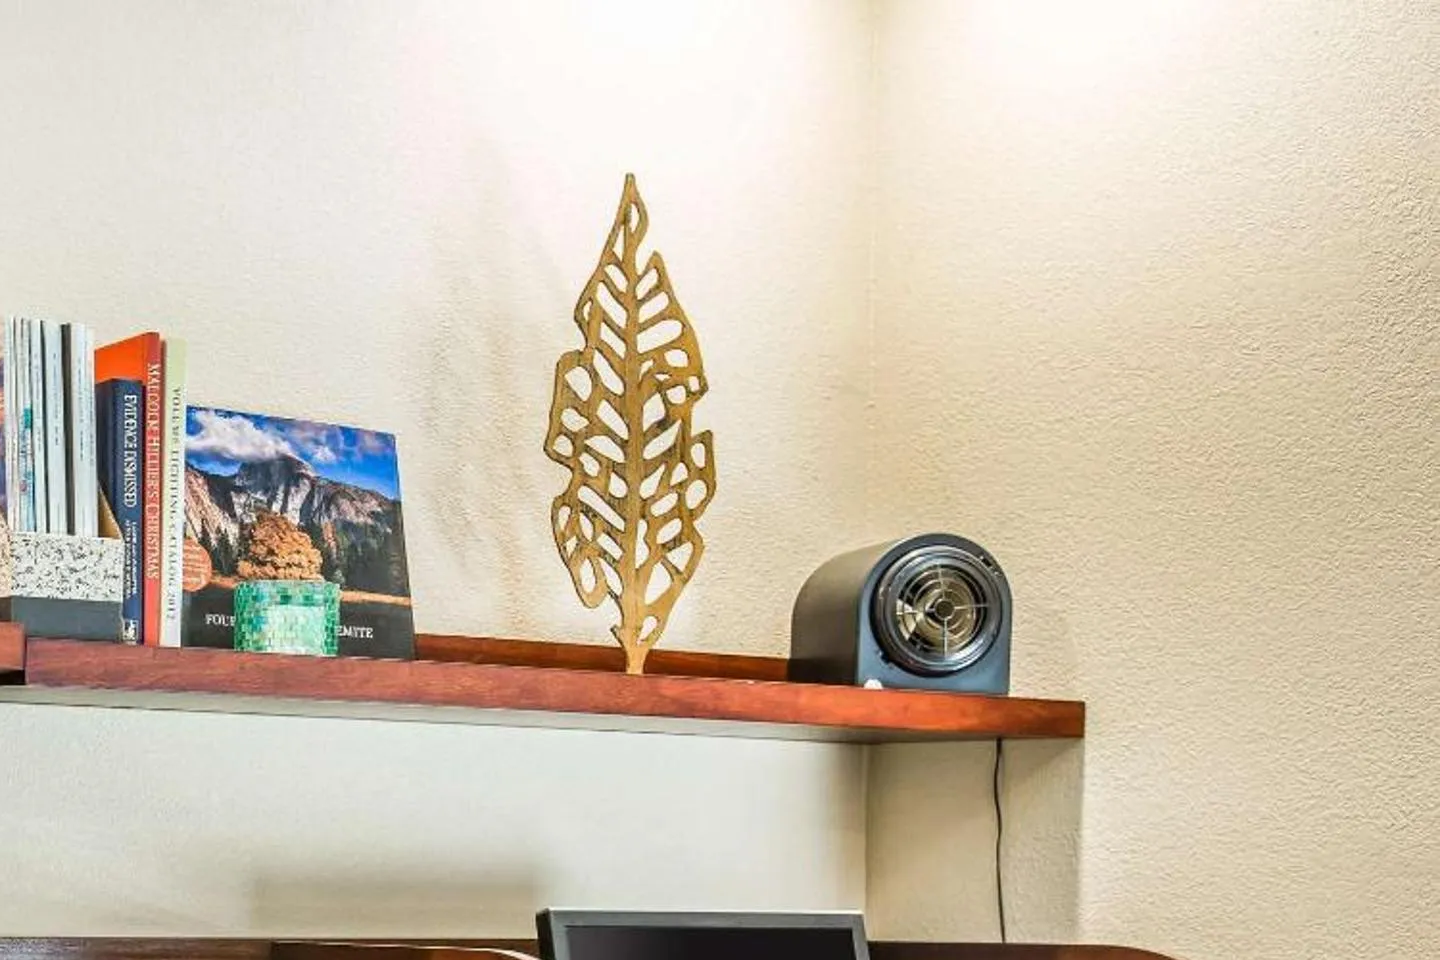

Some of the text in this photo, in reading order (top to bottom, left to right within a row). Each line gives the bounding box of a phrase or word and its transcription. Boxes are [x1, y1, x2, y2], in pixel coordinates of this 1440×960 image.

[124, 394, 137, 448] EVIDENCE
[123, 450, 137, 508] DISMISSED
[144, 502, 160, 580] CHRISTMAS
